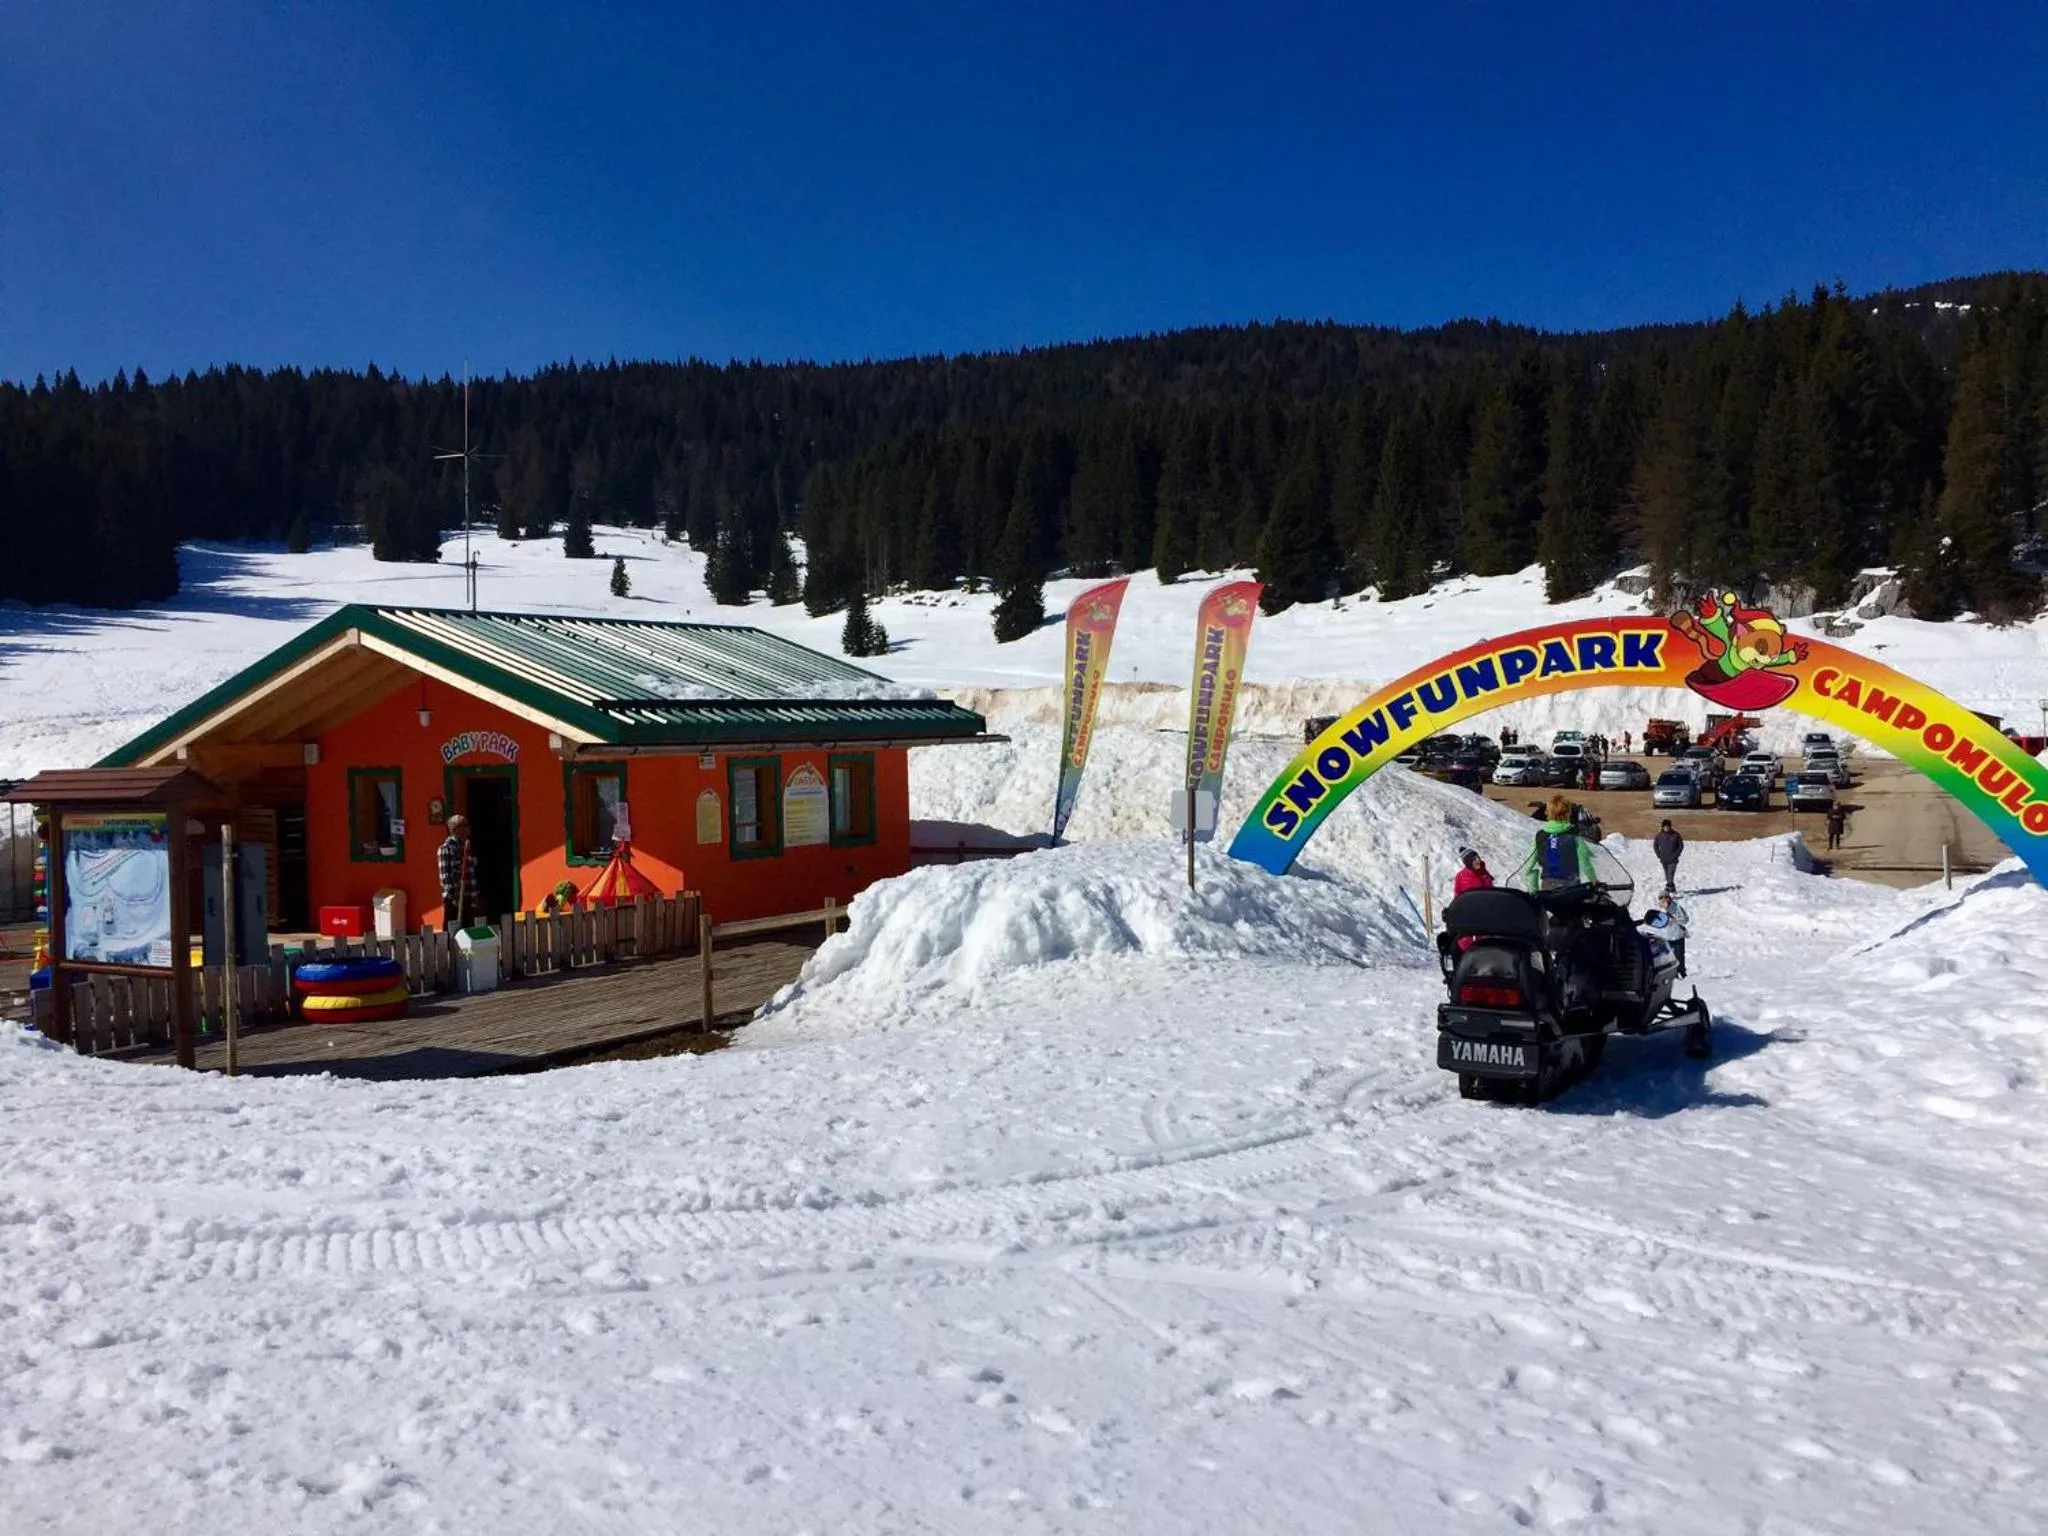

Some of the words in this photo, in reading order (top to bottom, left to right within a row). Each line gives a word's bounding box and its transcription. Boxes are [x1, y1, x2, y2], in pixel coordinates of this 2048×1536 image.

[1265, 631, 1667, 838] SNOWFUNPARK
[1813, 668, 2048, 834] CAMPOMULO
[1451, 1041, 1525, 1066] YAMAHA
